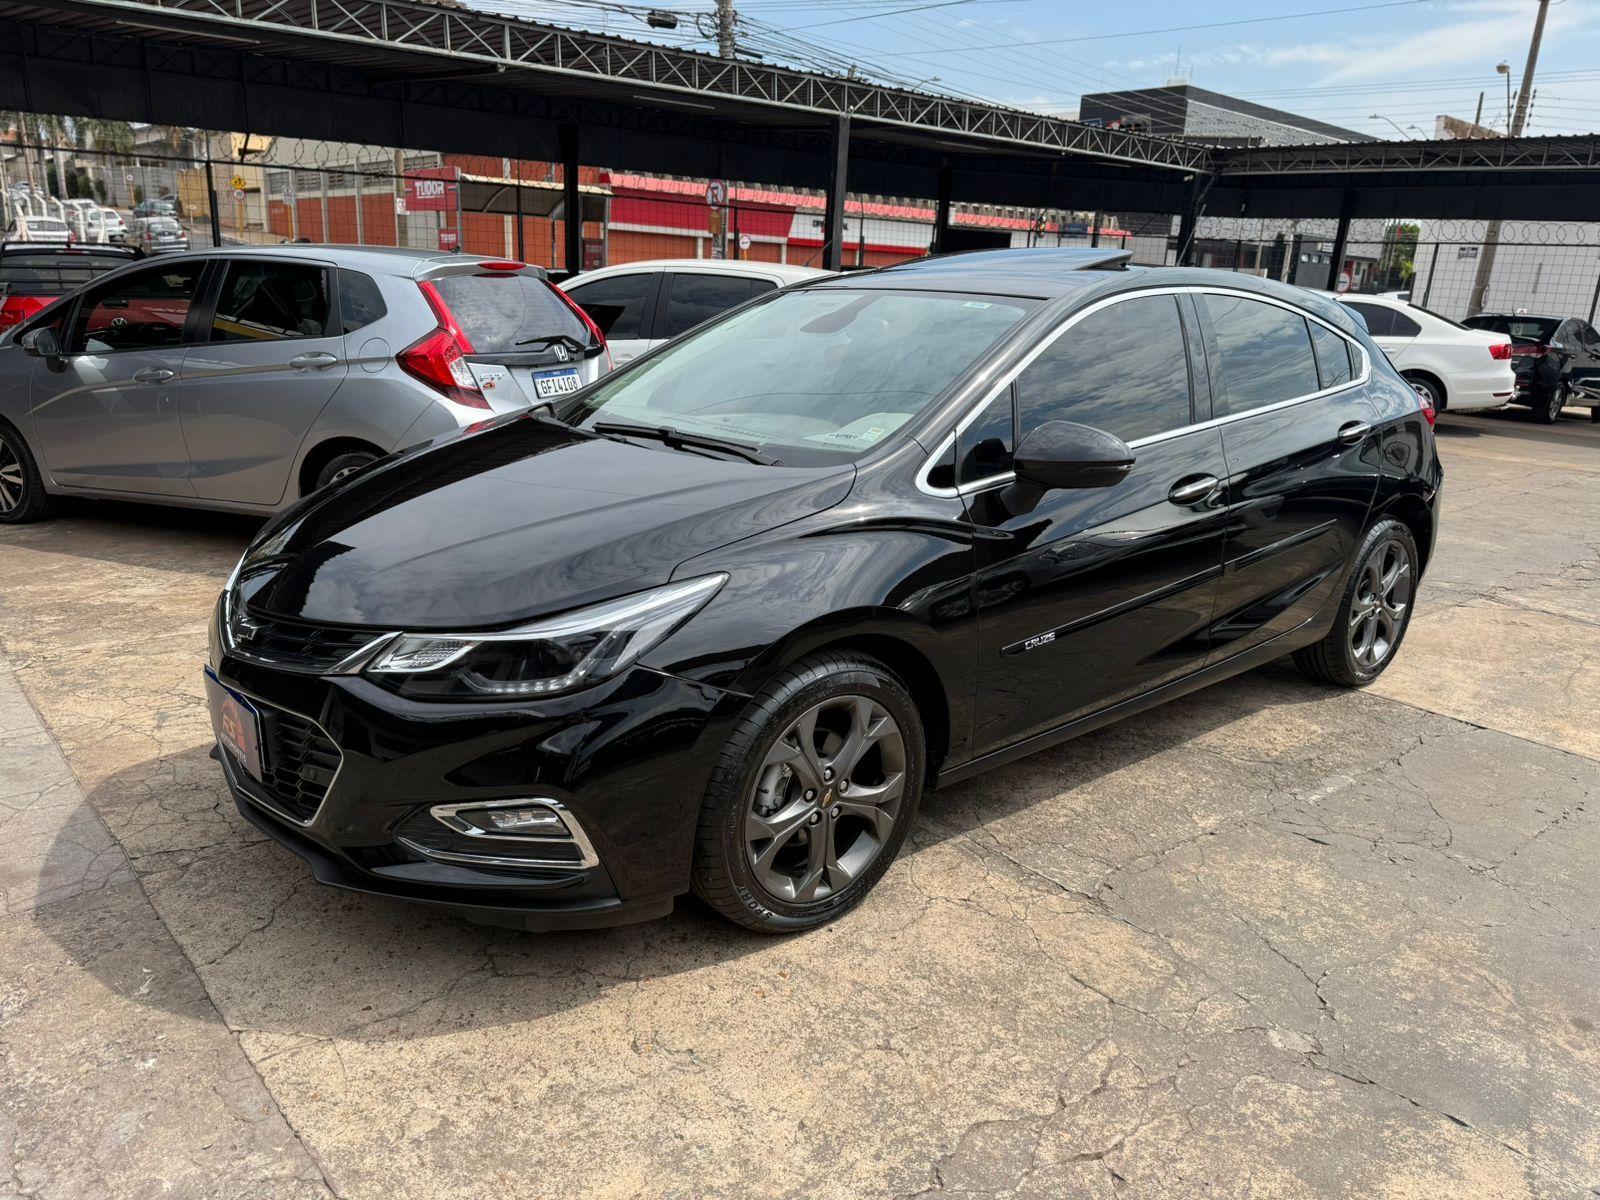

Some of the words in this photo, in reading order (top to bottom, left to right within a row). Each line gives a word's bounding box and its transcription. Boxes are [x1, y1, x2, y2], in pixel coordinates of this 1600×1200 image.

[415, 181, 445, 195] TUDOR
[1025, 632, 1056, 650] CRUZE
[735, 885, 773, 921] SPORT
